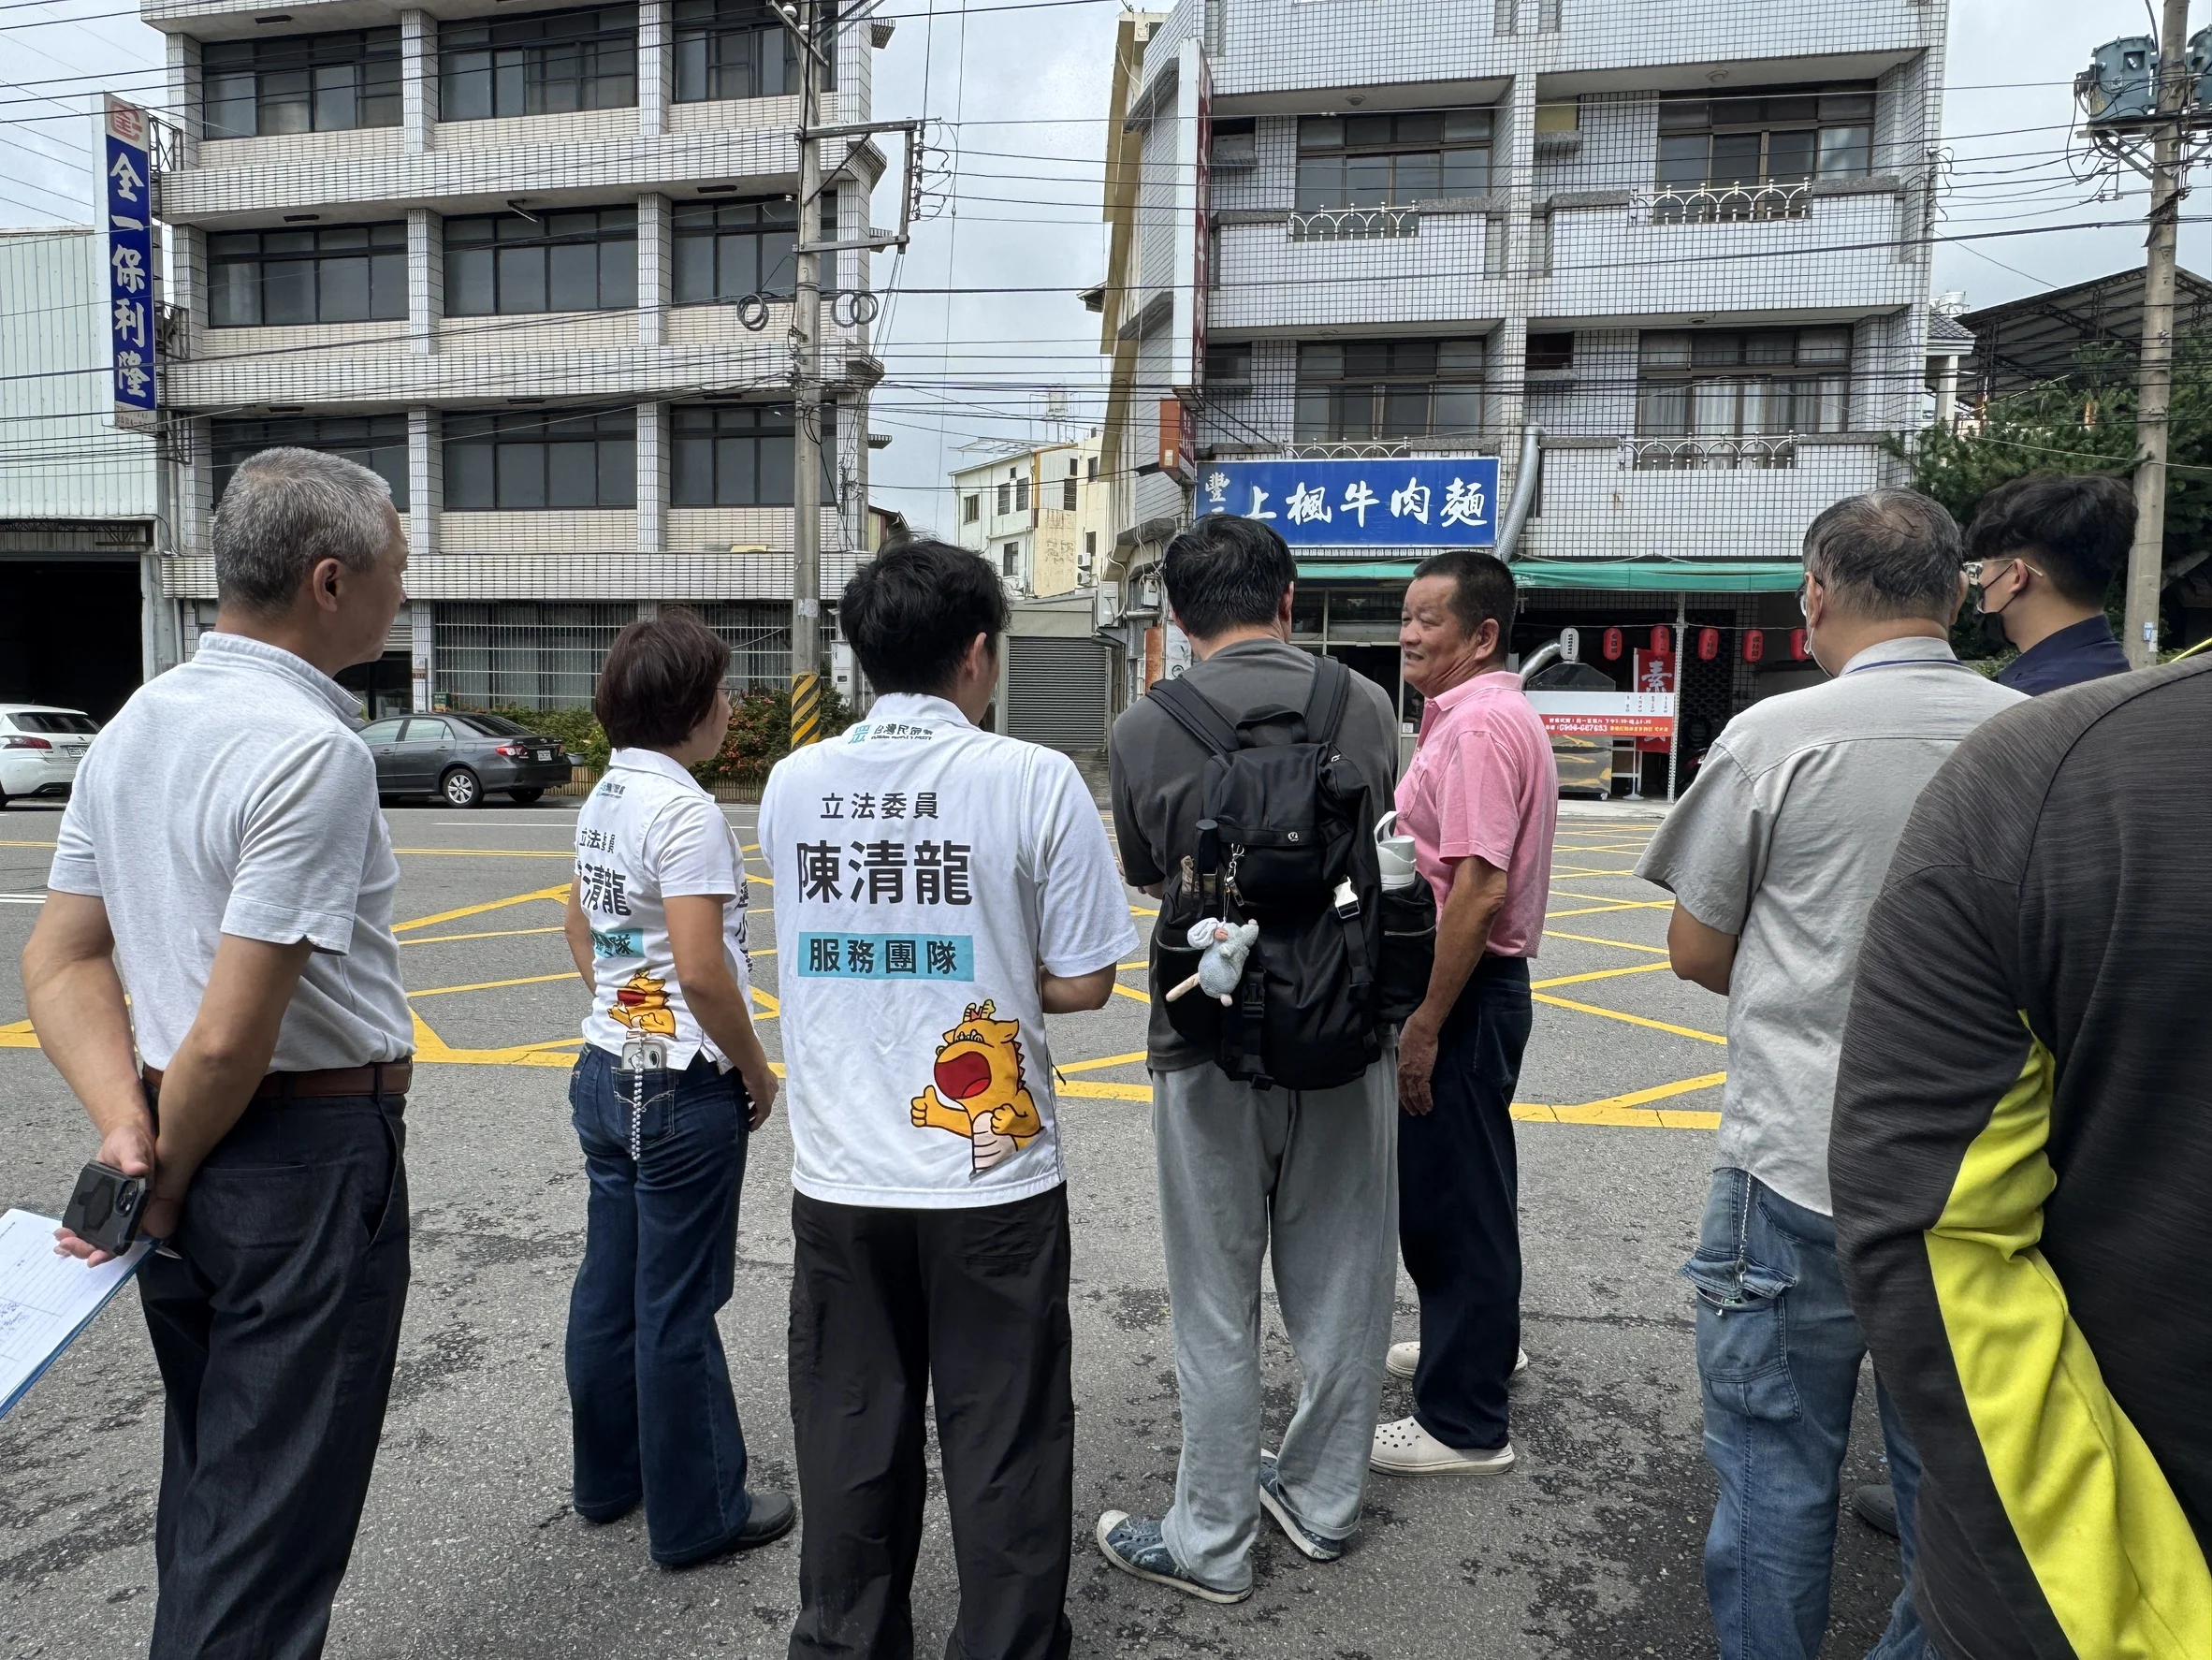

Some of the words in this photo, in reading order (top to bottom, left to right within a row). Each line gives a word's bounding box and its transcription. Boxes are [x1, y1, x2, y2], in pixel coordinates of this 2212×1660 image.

[1205, 472, 1230, 514] 豐
[1241, 475, 1489, 529] 上楓牛肉麵
[820, 792, 939, 821] 立法委員
[796, 839, 973, 906] 陳清龍
[808, 938, 958, 975] 服務團隊
